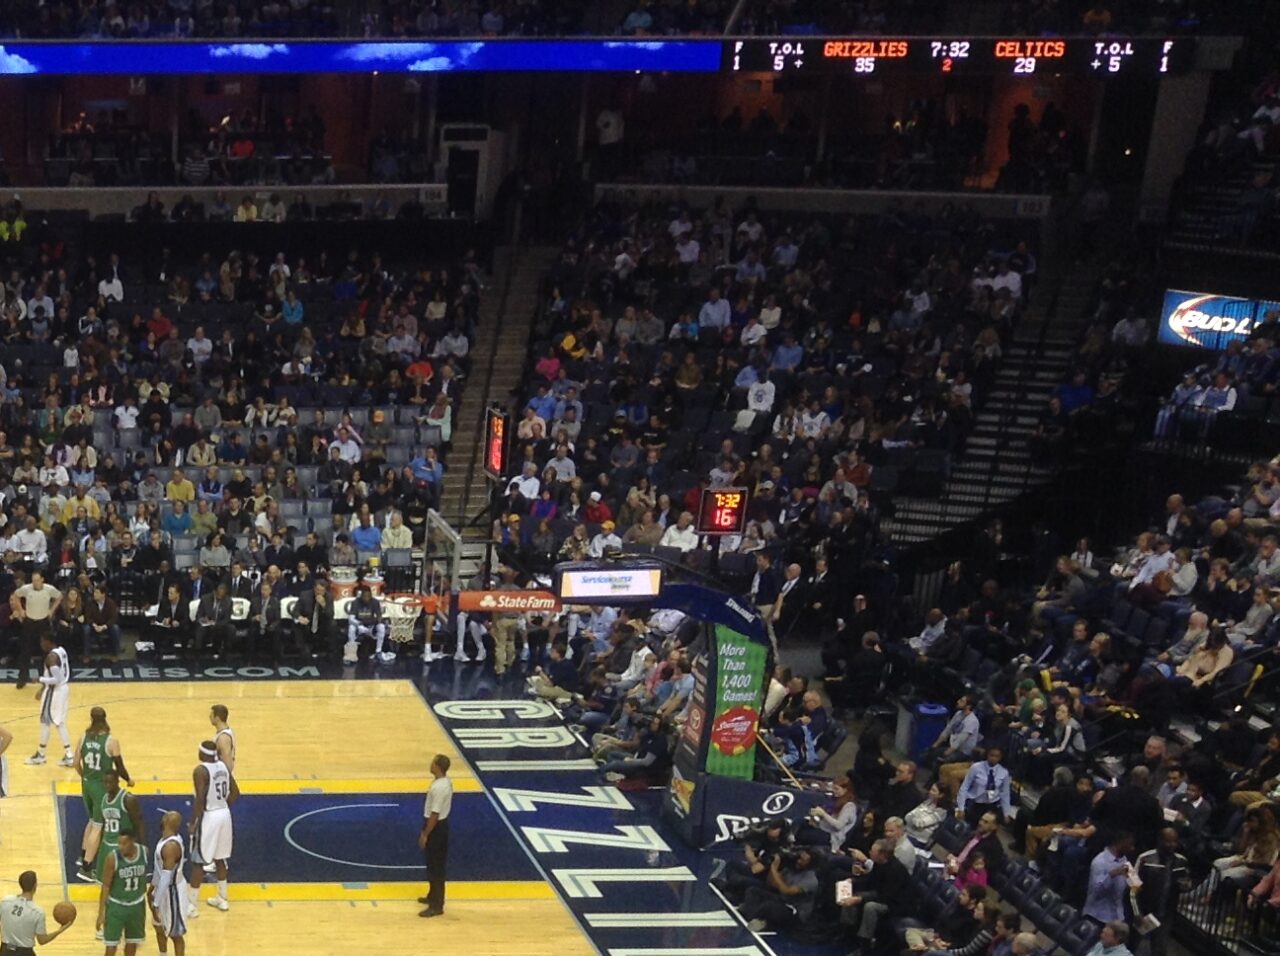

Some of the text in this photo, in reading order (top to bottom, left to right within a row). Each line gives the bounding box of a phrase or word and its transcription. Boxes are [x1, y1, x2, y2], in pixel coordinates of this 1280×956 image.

[824, 42, 907, 57] GRIZZLIES
[931, 42, 970, 57] 7:32
[995, 42, 1065, 57] CELTICS
[774, 57, 784, 70] 5
[855, 57, 874, 72] 35
[942, 58, 952, 71] 2
[1014, 57, 1035, 72] 29
[1108, 57, 1121, 71] 5
[715, 494, 740, 508] 7:32
[715, 509, 732, 526] 16
[720, 643, 746, 656] More
[723, 659, 746, 671] Than
[722, 674, 752, 688] 1,400
[84, 752, 101, 770] 41
[214, 781, 228, 800] 50
[124, 877, 139, 891] 11
[11, 904, 24, 917] 28
